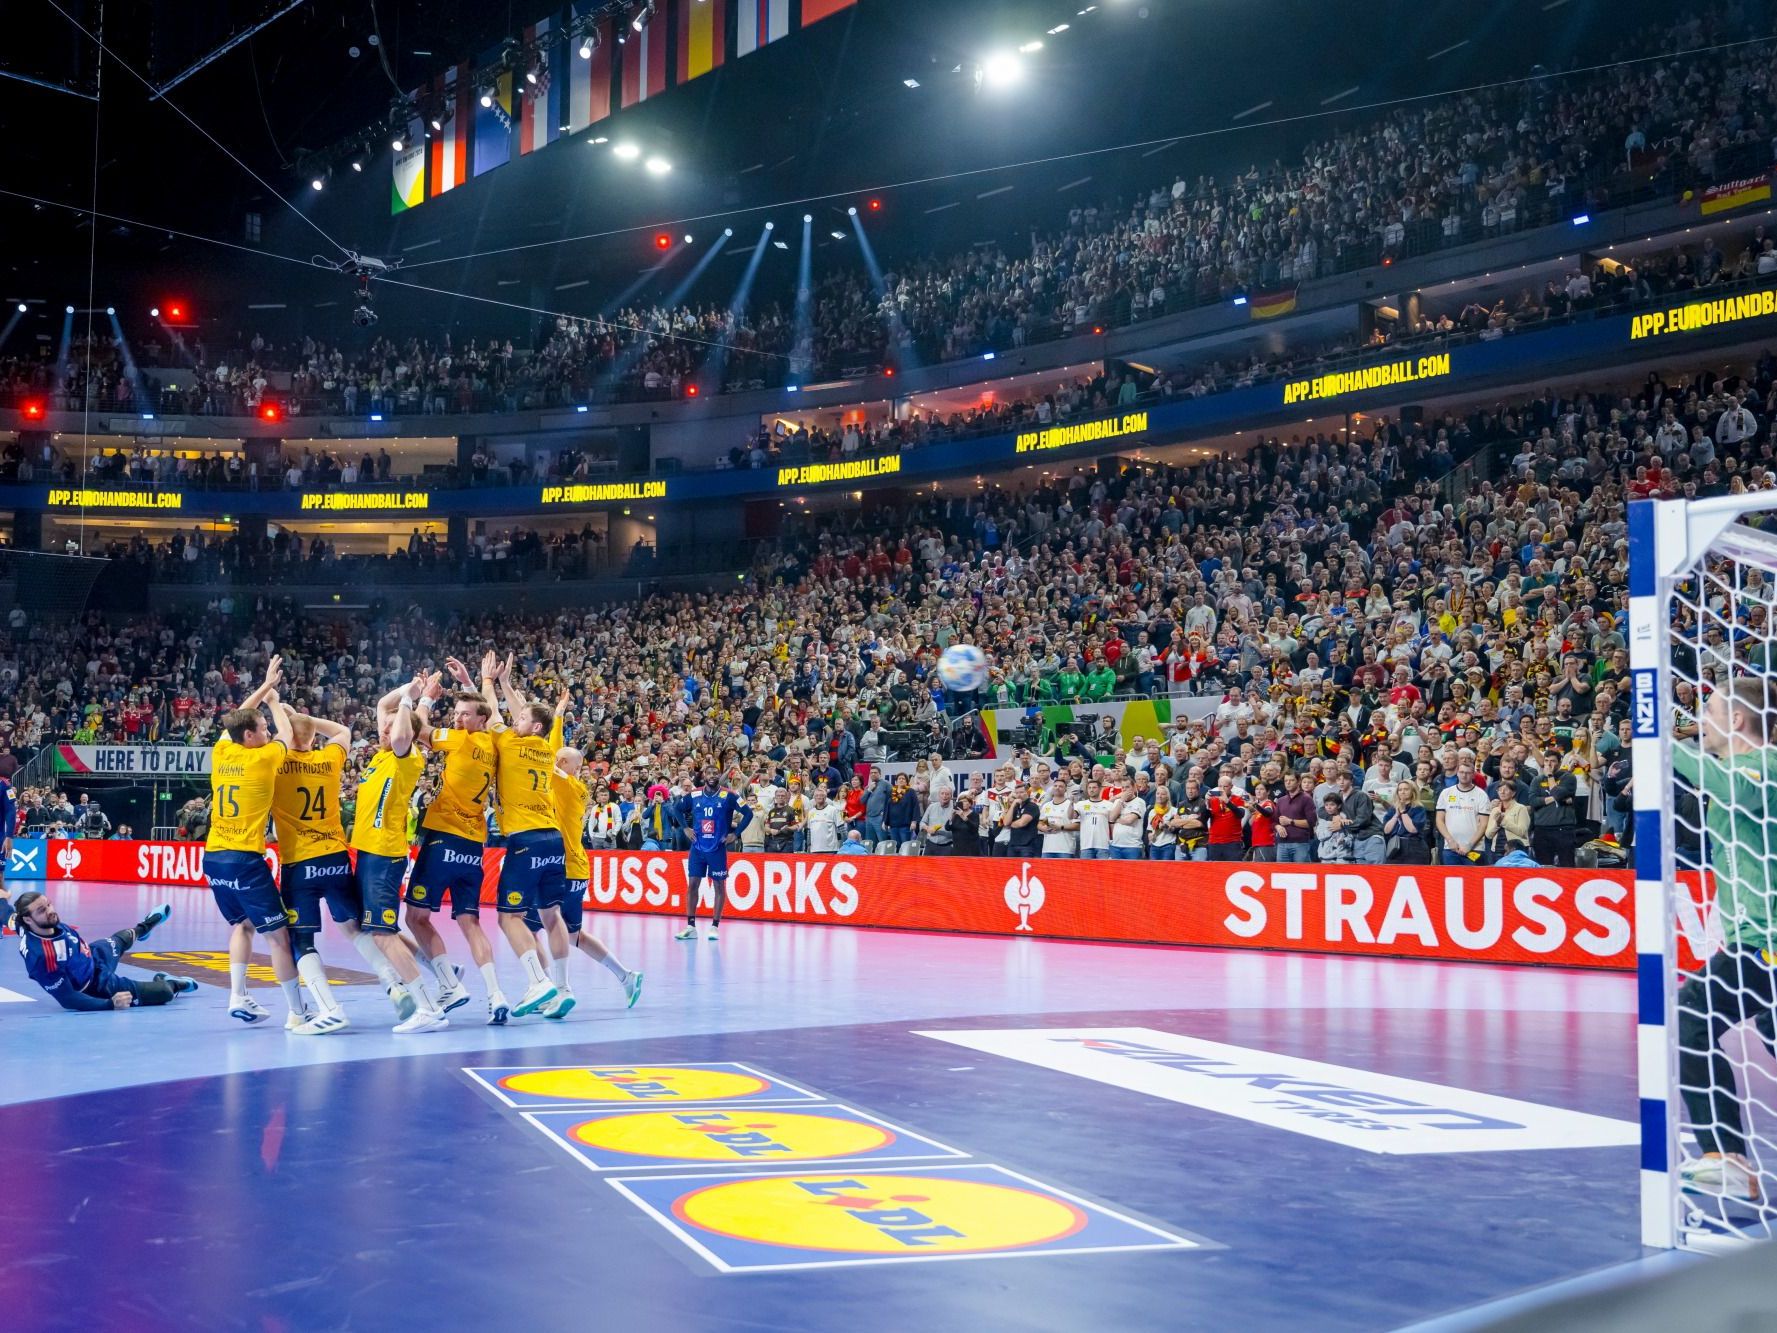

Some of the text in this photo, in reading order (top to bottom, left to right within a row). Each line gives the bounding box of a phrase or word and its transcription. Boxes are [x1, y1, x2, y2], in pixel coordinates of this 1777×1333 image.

[1631, 290, 1777, 339] APP.EUROHANDBA
[1283, 353, 1450, 404] APP.EUROHANDBALL.COM
[1016, 412, 1147, 452] APP.EUROHANDBALL.COM
[777, 455, 900, 486] APP.EUROHANDBALL.COM
[48, 490, 181, 508] APP.EUROHANDBALL.COM
[301, 493, 428, 509] APP.EUROHANDBALL.COM
[541, 481, 666, 503] APP.EUROHANDBALL.COM
[96, 750, 206, 772] HERE TO PLAY
[217, 784, 240, 818] 15
[296, 785, 327, 821] 24
[703, 807, 713, 817] 10
[138, 844, 205, 881] STRAU
[304, 862, 351, 880] Boozt
